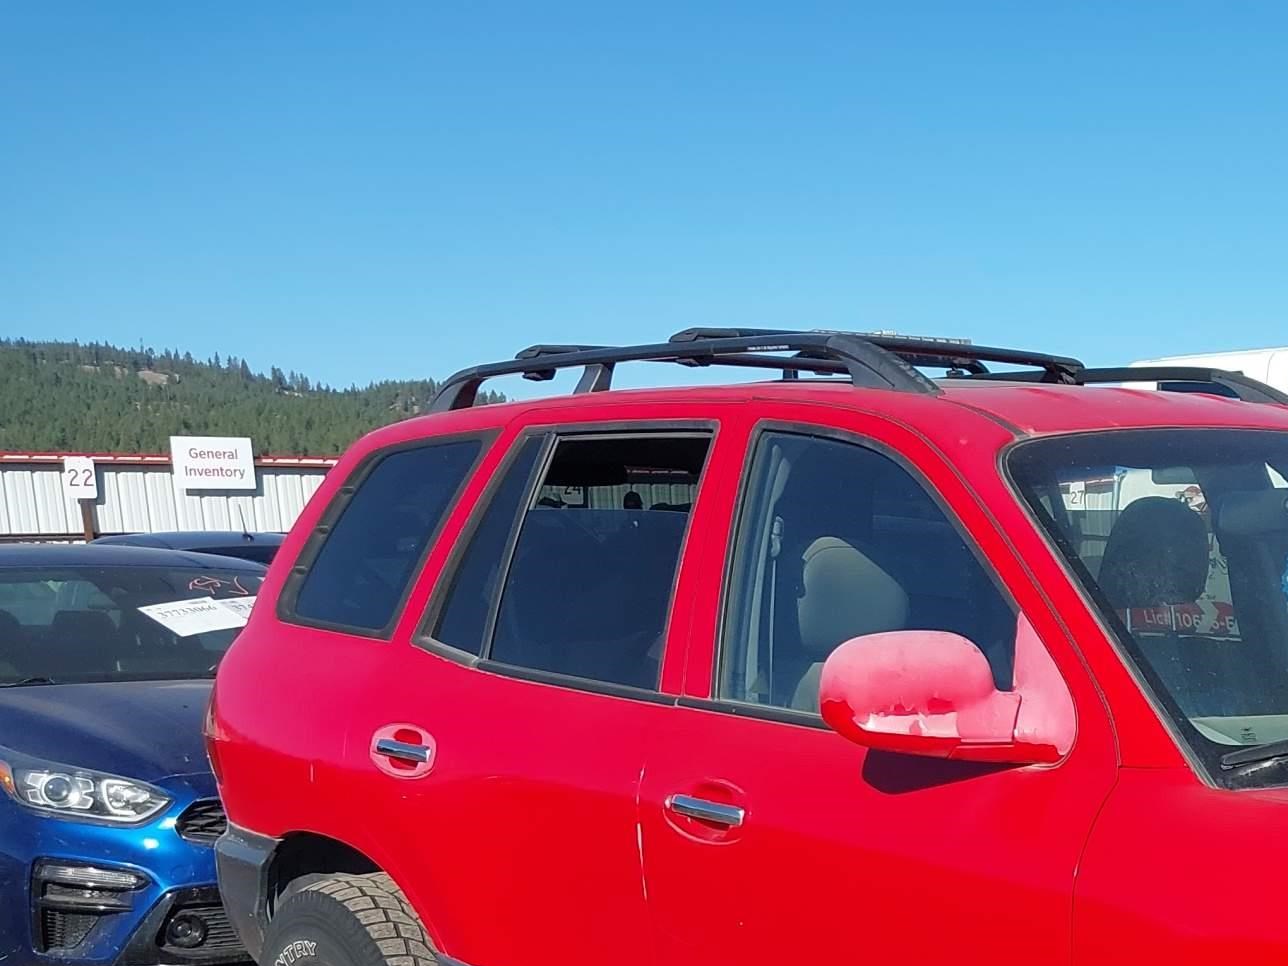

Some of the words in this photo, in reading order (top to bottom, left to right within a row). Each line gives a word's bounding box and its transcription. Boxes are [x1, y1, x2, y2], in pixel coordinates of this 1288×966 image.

[188, 447, 239, 460] General
[67, 467, 95, 487] 22
[184, 465, 246, 480] Inventory
[1070, 490, 1085, 504] 27
